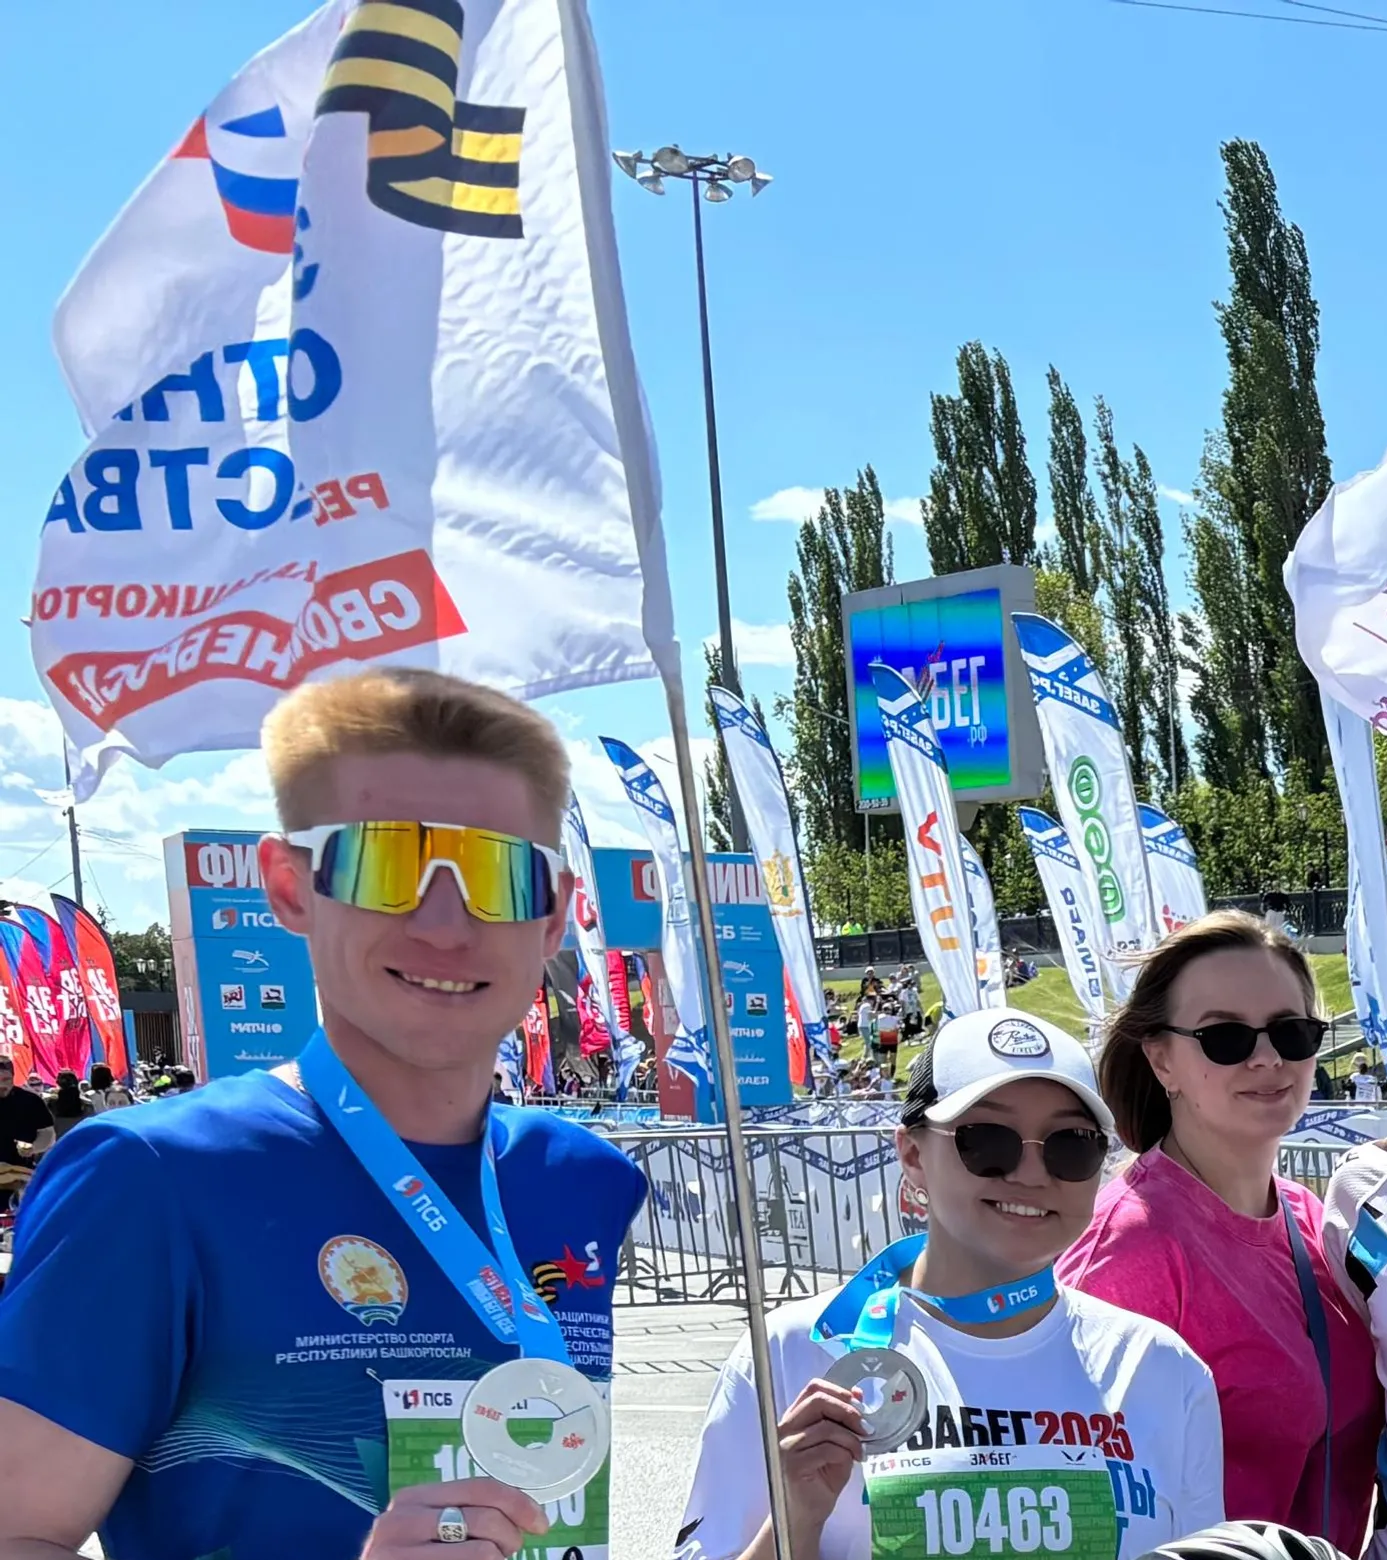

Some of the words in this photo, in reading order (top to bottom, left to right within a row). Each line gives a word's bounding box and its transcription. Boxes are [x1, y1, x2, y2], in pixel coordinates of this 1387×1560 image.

[411, 1193, 448, 1233] ПСБ
[1008, 1284, 1039, 1306] ПСБ
[295, 1332, 407, 1348] МИНИСТЕРСТВО
[409, 1332, 455, 1345] СПОРТА
[275, 1348, 378, 1364] РЕСПУБЛИКИ
[380, 1347, 472, 1359] БАШКОРТОСТАН
[423, 1392, 453, 1407] ПСБ
[900, 1456, 932, 1468] ПСБ
[915, 1485, 1073, 1556] 10463
